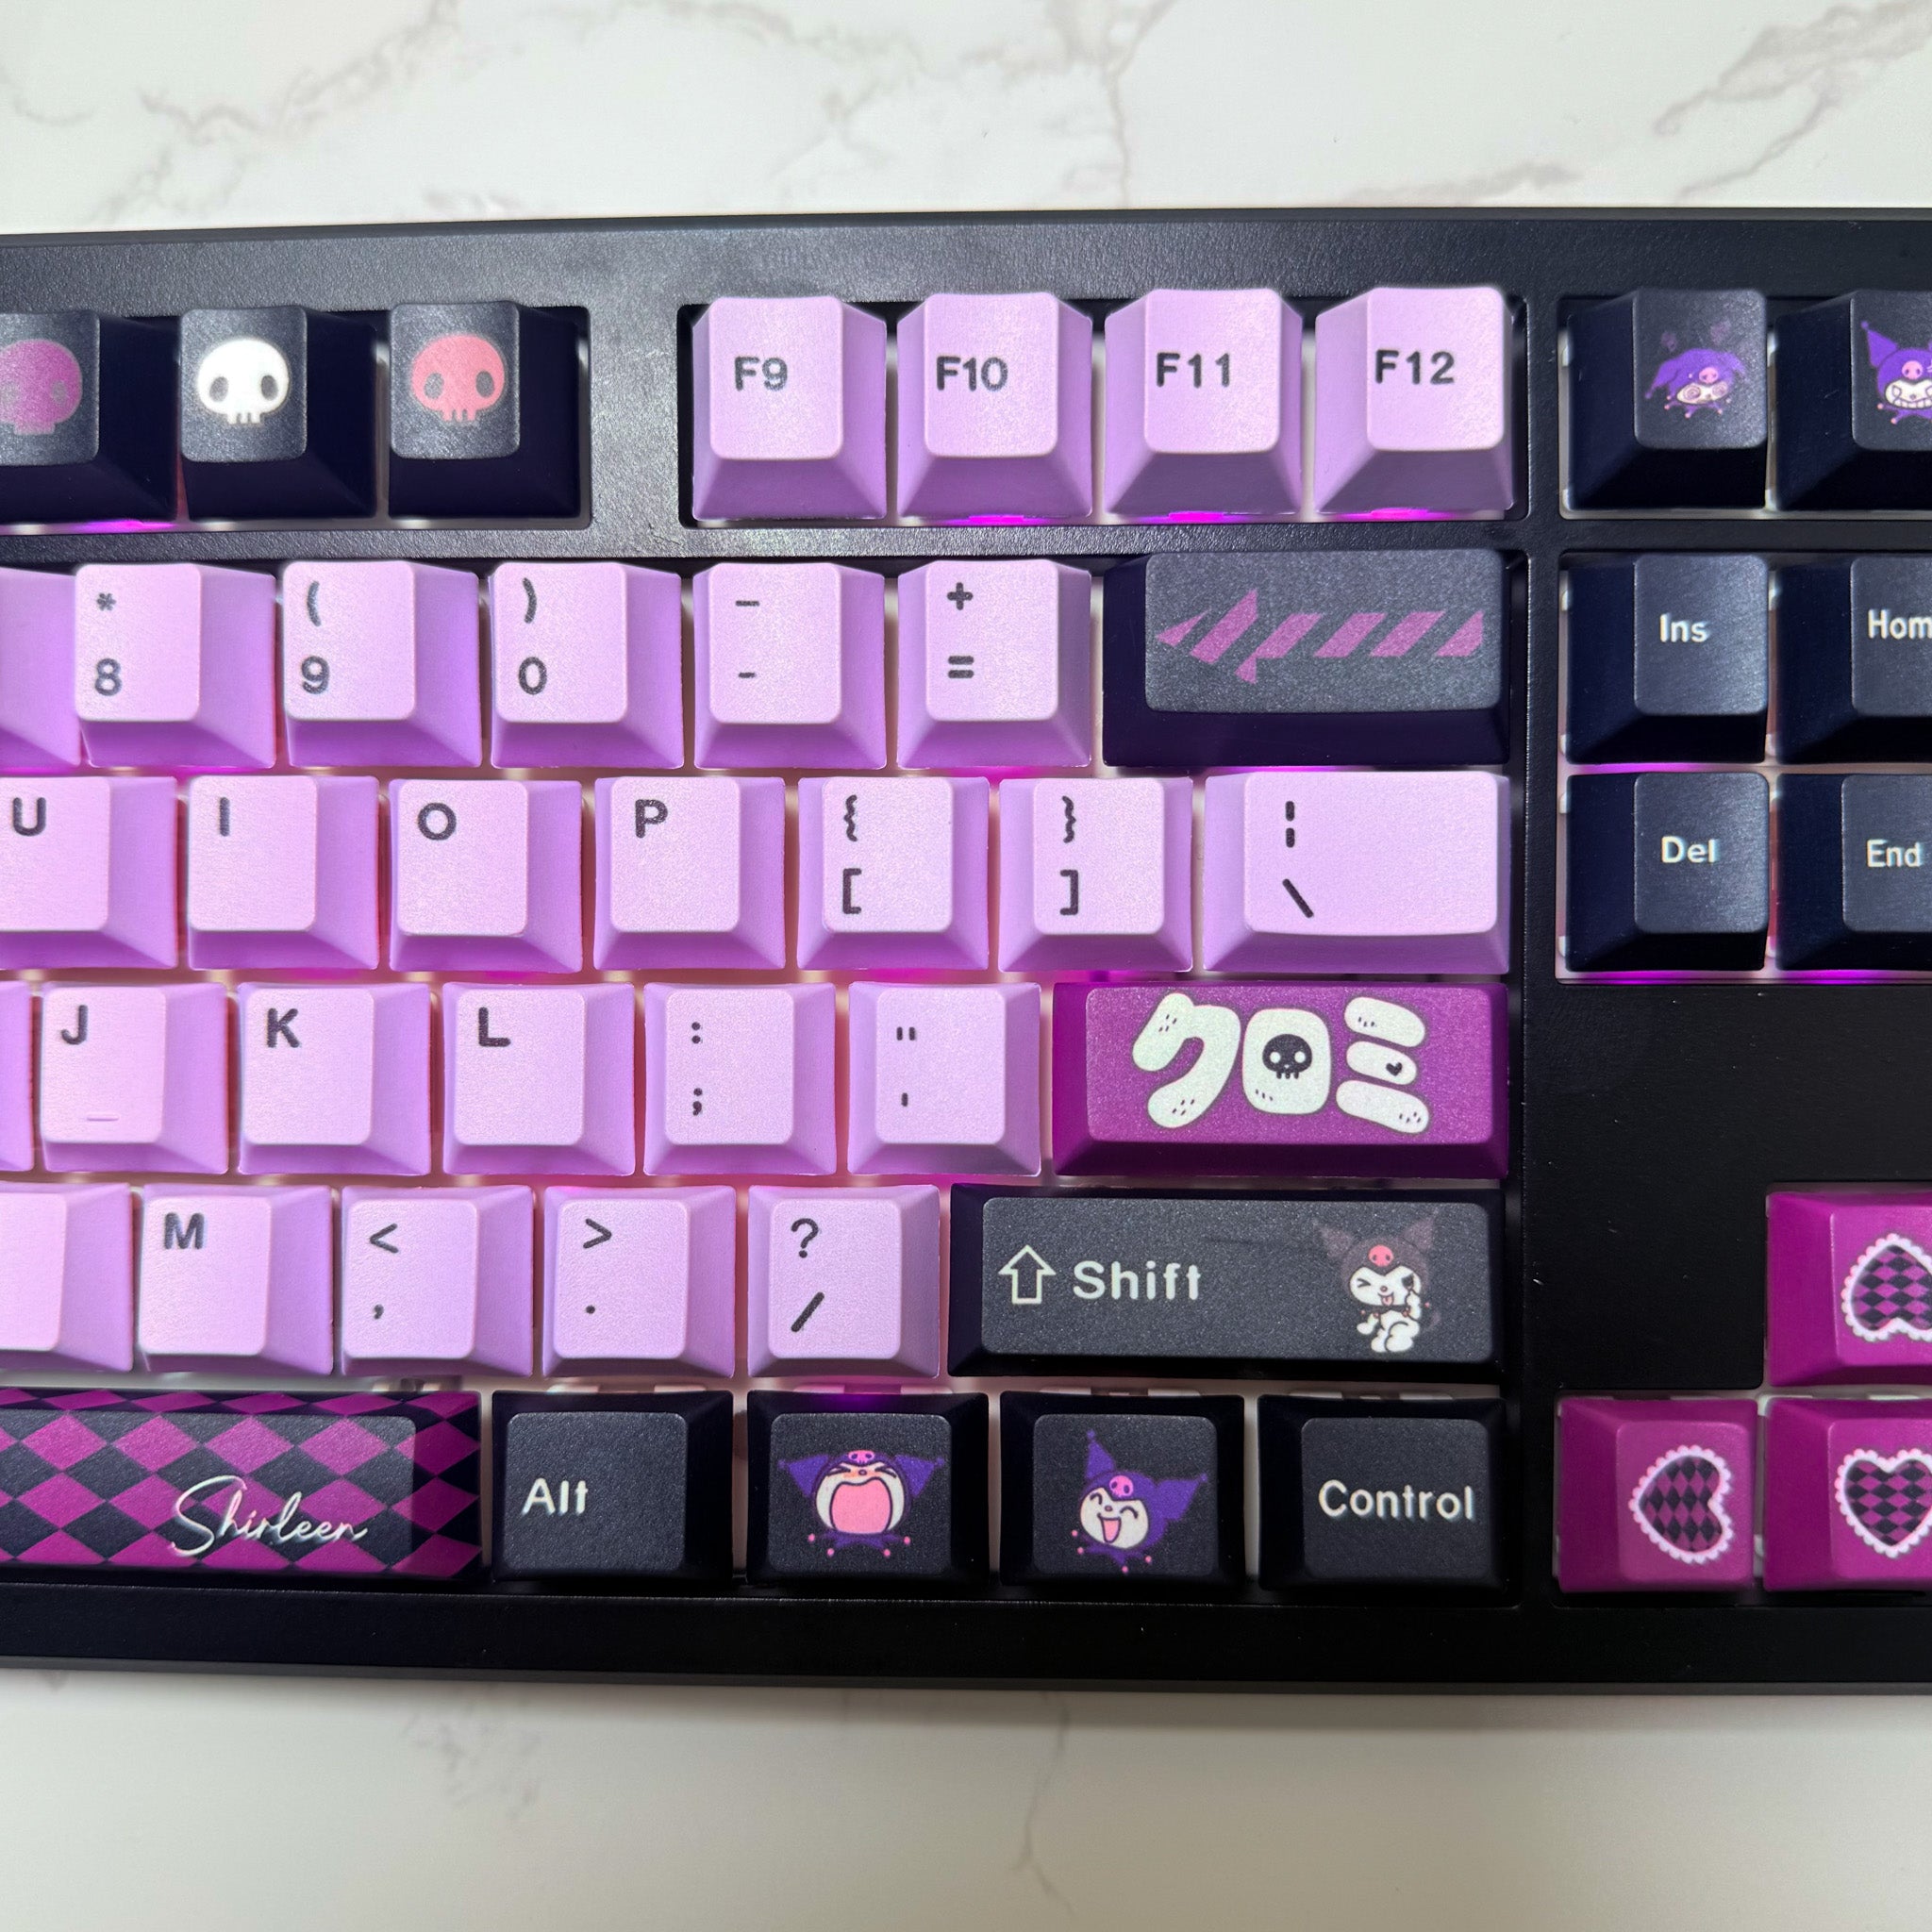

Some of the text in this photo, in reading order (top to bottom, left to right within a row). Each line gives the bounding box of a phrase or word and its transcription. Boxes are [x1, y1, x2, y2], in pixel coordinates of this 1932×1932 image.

[735, 357, 787, 391] F9
[937, 356, 1008, 391] F10
[1157, 353, 1229, 388] F11
[1375, 350, 1454, 384] F12
[306, 580, 322, 627] (
[522, 577, 538, 625] )
[947, 582, 973, 610] +
[1660, 614, 1709, 641] Ins
[1869, 610, 1932, 639] Hom
[94, 658, 121, 696] 8
[301, 656, 329, 694] 9
[518, 658, 547, 695] 0
[948, 656, 974, 678] =
[12, 797, 45, 836] U
[218, 796, 230, 837] I
[418, 803, 457, 841] O
[635, 799, 668, 838] P
[843, 795, 858, 841] {
[1062, 796, 1076, 843] }
[1662, 837, 1717, 862] Del
[1868, 840, 1923, 867] End
[842, 868, 861, 914] [
[1060, 870, 1078, 915] ]
[1283, 879, 1313, 918] \
[61, 1005, 87, 1045] J
[267, 1008, 299, 1048] K
[478, 1007, 510, 1047] L
[691, 1021, 702, 1044] :
[896, 1026, 917, 1041] "
[691, 1088, 703, 1117] ;
[164, 1213, 204, 1249] M
[370, 1224, 398, 1253] <
[583, 1219, 611, 1249] >
[791, 1219, 819, 1258] ?
[1074, 1260, 1201, 1300] Shift
[373, 1304, 384, 1320] ,
[585, 1305, 596, 1315] .
[791, 1292, 824, 1332] /
[172, 1475, 367, 1555] Shirleen
[523, 1478, 588, 1514] Alt
[1319, 1480, 1473, 1519] Control
